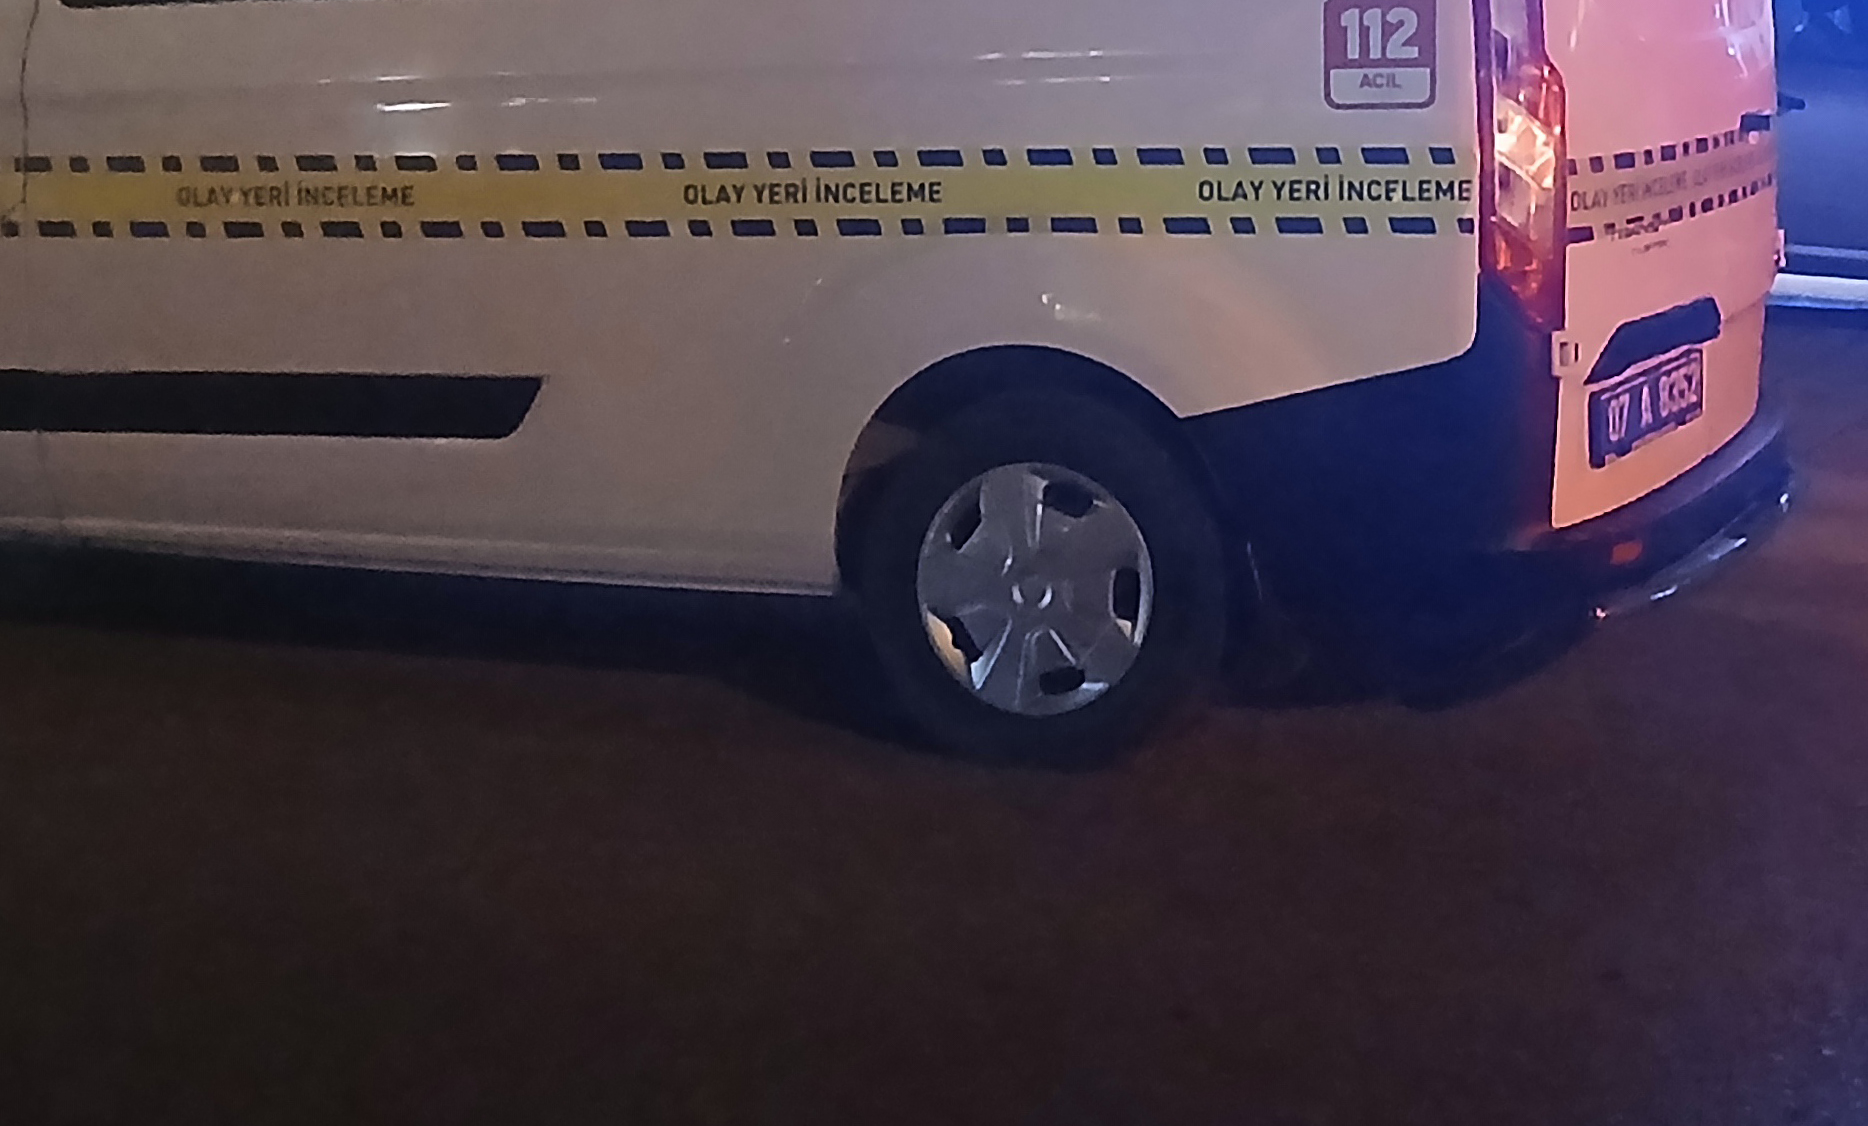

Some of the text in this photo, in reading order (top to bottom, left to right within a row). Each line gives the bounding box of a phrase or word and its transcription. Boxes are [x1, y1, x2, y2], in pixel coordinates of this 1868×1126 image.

[1339, 6, 1420, 61] 112
[176, 185, 233, 208] OLAY
[683, 183, 746, 206] OLAY
[1198, 178, 1264, 202] OLAY
[1608, 393, 1630, 442] 07
[1640, 384, 1654, 429] A
